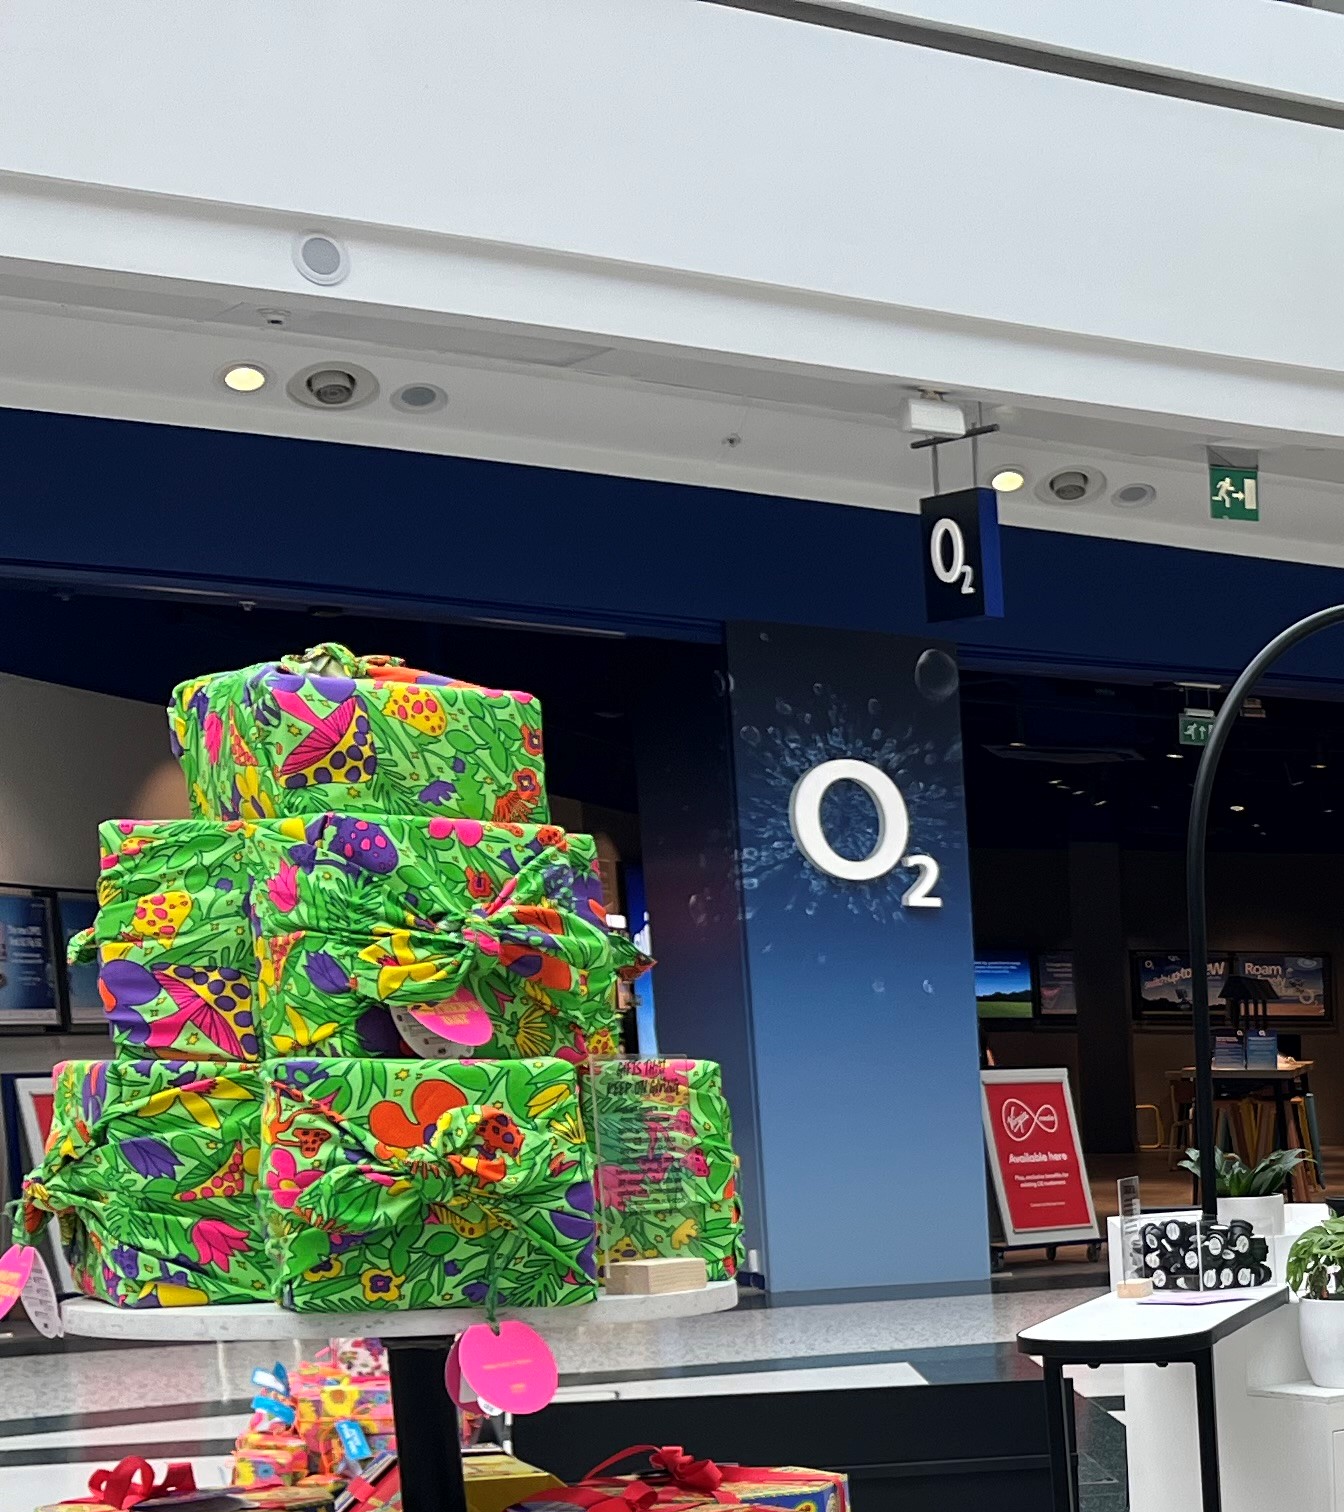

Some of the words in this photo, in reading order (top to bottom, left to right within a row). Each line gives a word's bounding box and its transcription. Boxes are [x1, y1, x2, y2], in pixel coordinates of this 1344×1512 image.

[1244, 962, 1283, 975] Roam
[1008, 1152, 1048, 1164] Available
[1048, 1151, 1068, 1162] here
